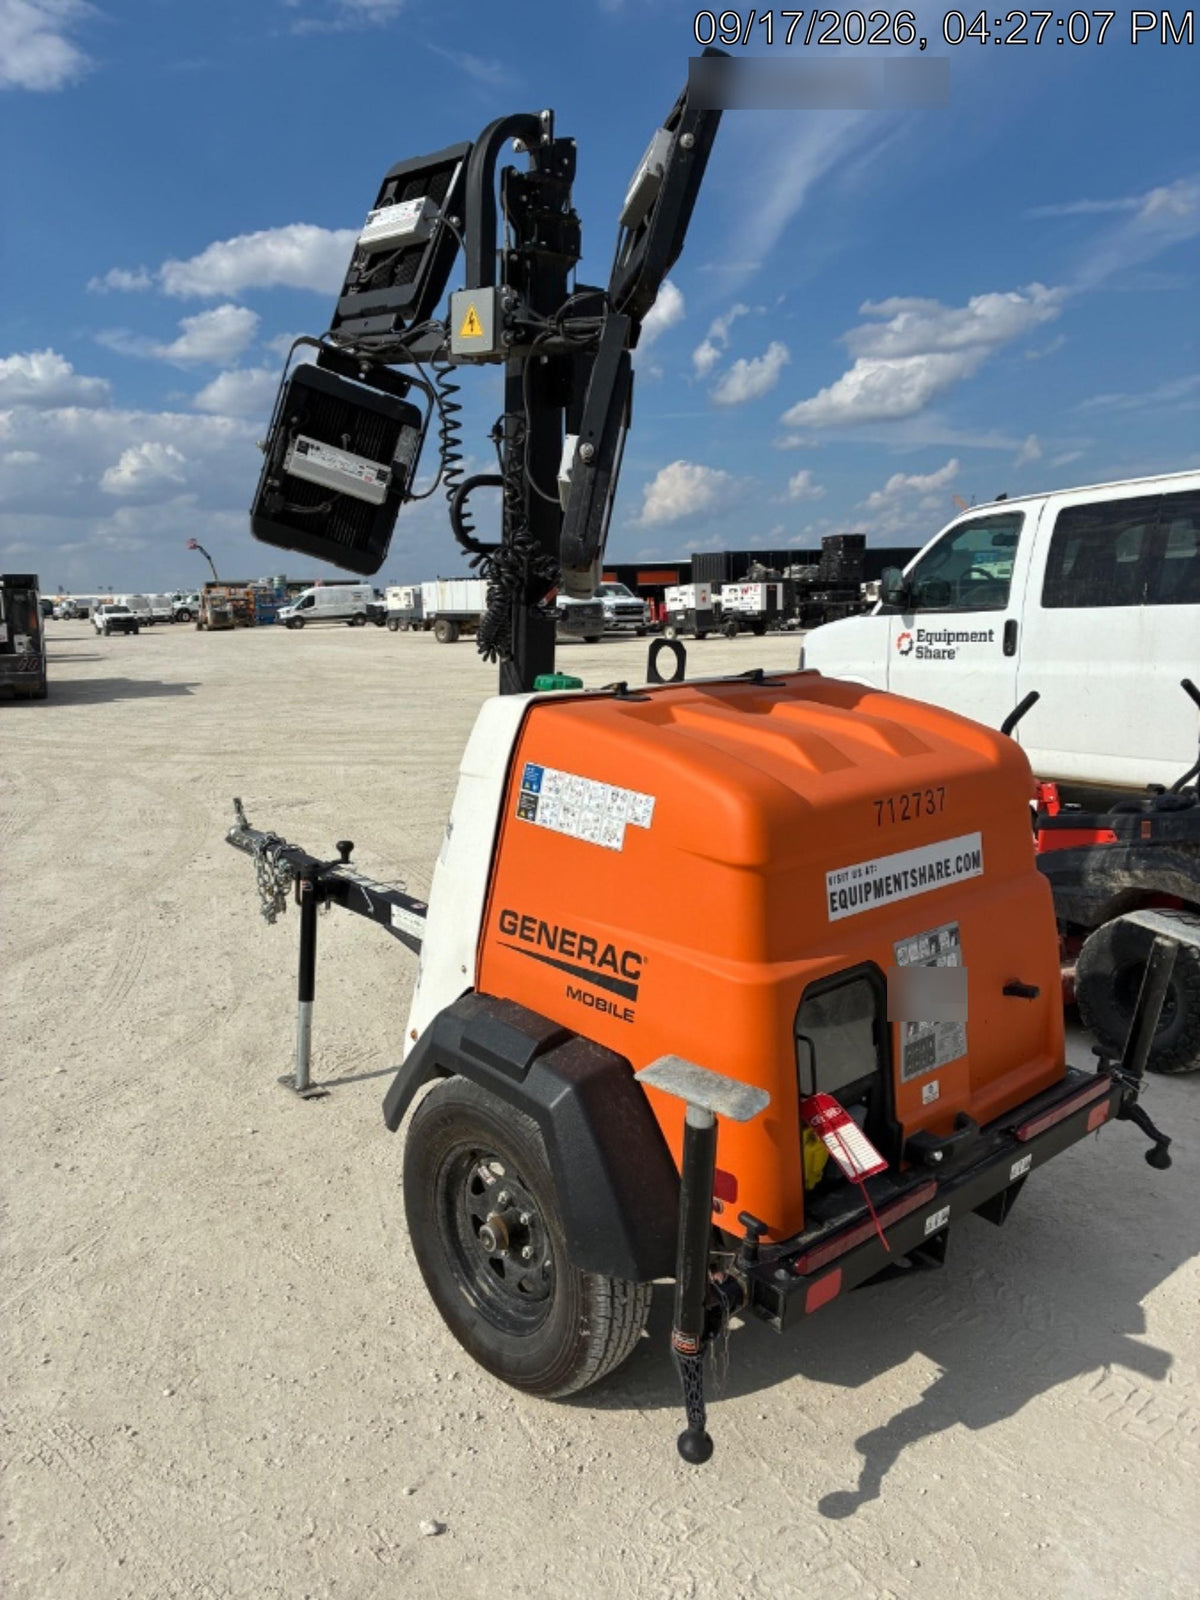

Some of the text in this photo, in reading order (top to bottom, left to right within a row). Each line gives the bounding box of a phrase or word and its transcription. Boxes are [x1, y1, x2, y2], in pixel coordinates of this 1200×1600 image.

[915, 645, 956, 660] Share
[916, 629, 995, 646] Equipment
[873, 787, 945, 827] 712737
[828, 863, 878, 887] VISIT US AT:
[829, 850, 981, 913] EQUIPMENTSHARE.COM
[498, 908, 642, 981] GENERAC
[566, 985, 636, 1024] MOBILE
